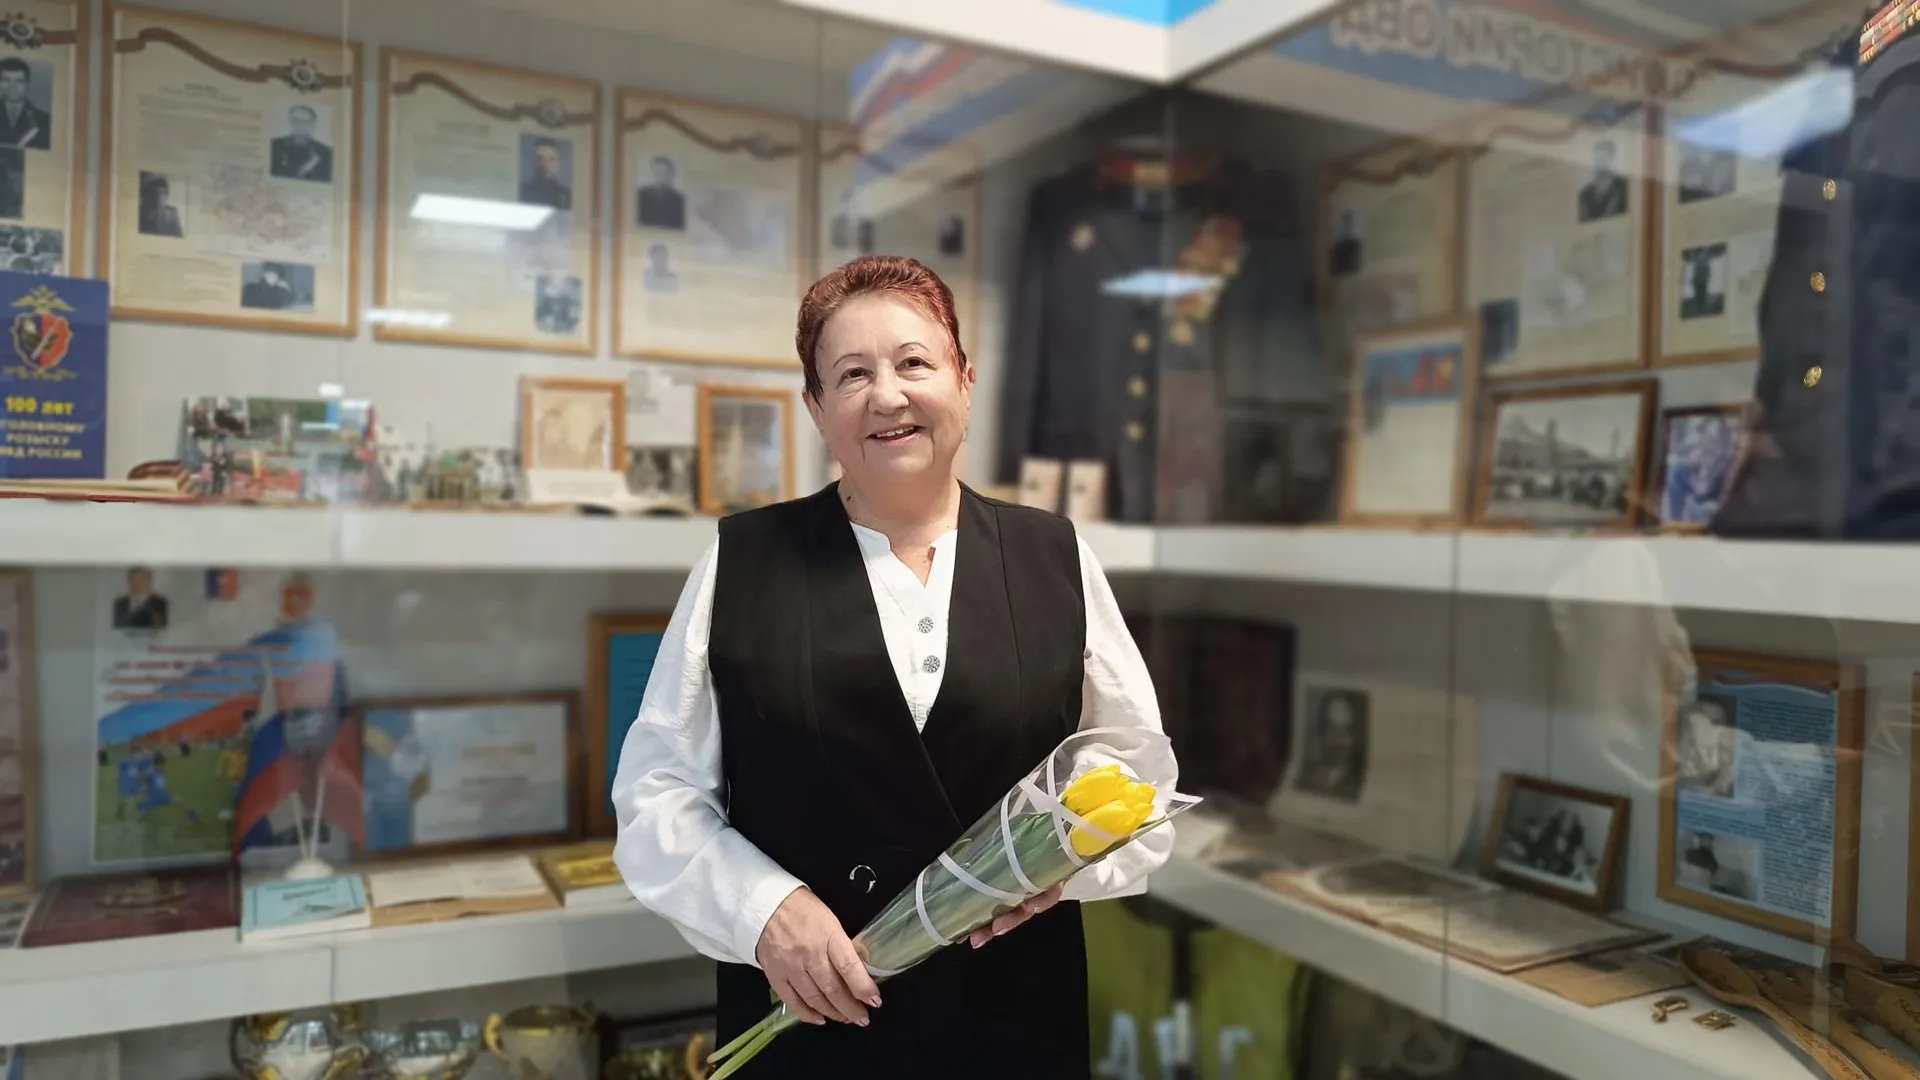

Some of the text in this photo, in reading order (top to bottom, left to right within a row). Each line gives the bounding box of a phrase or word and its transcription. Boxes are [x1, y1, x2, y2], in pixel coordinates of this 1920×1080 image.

[5, 396, 73, 415] 100 лет
[6, 433, 70, 445] РОЗЫСКУ
[27, 447, 82, 459] РОССИИ
